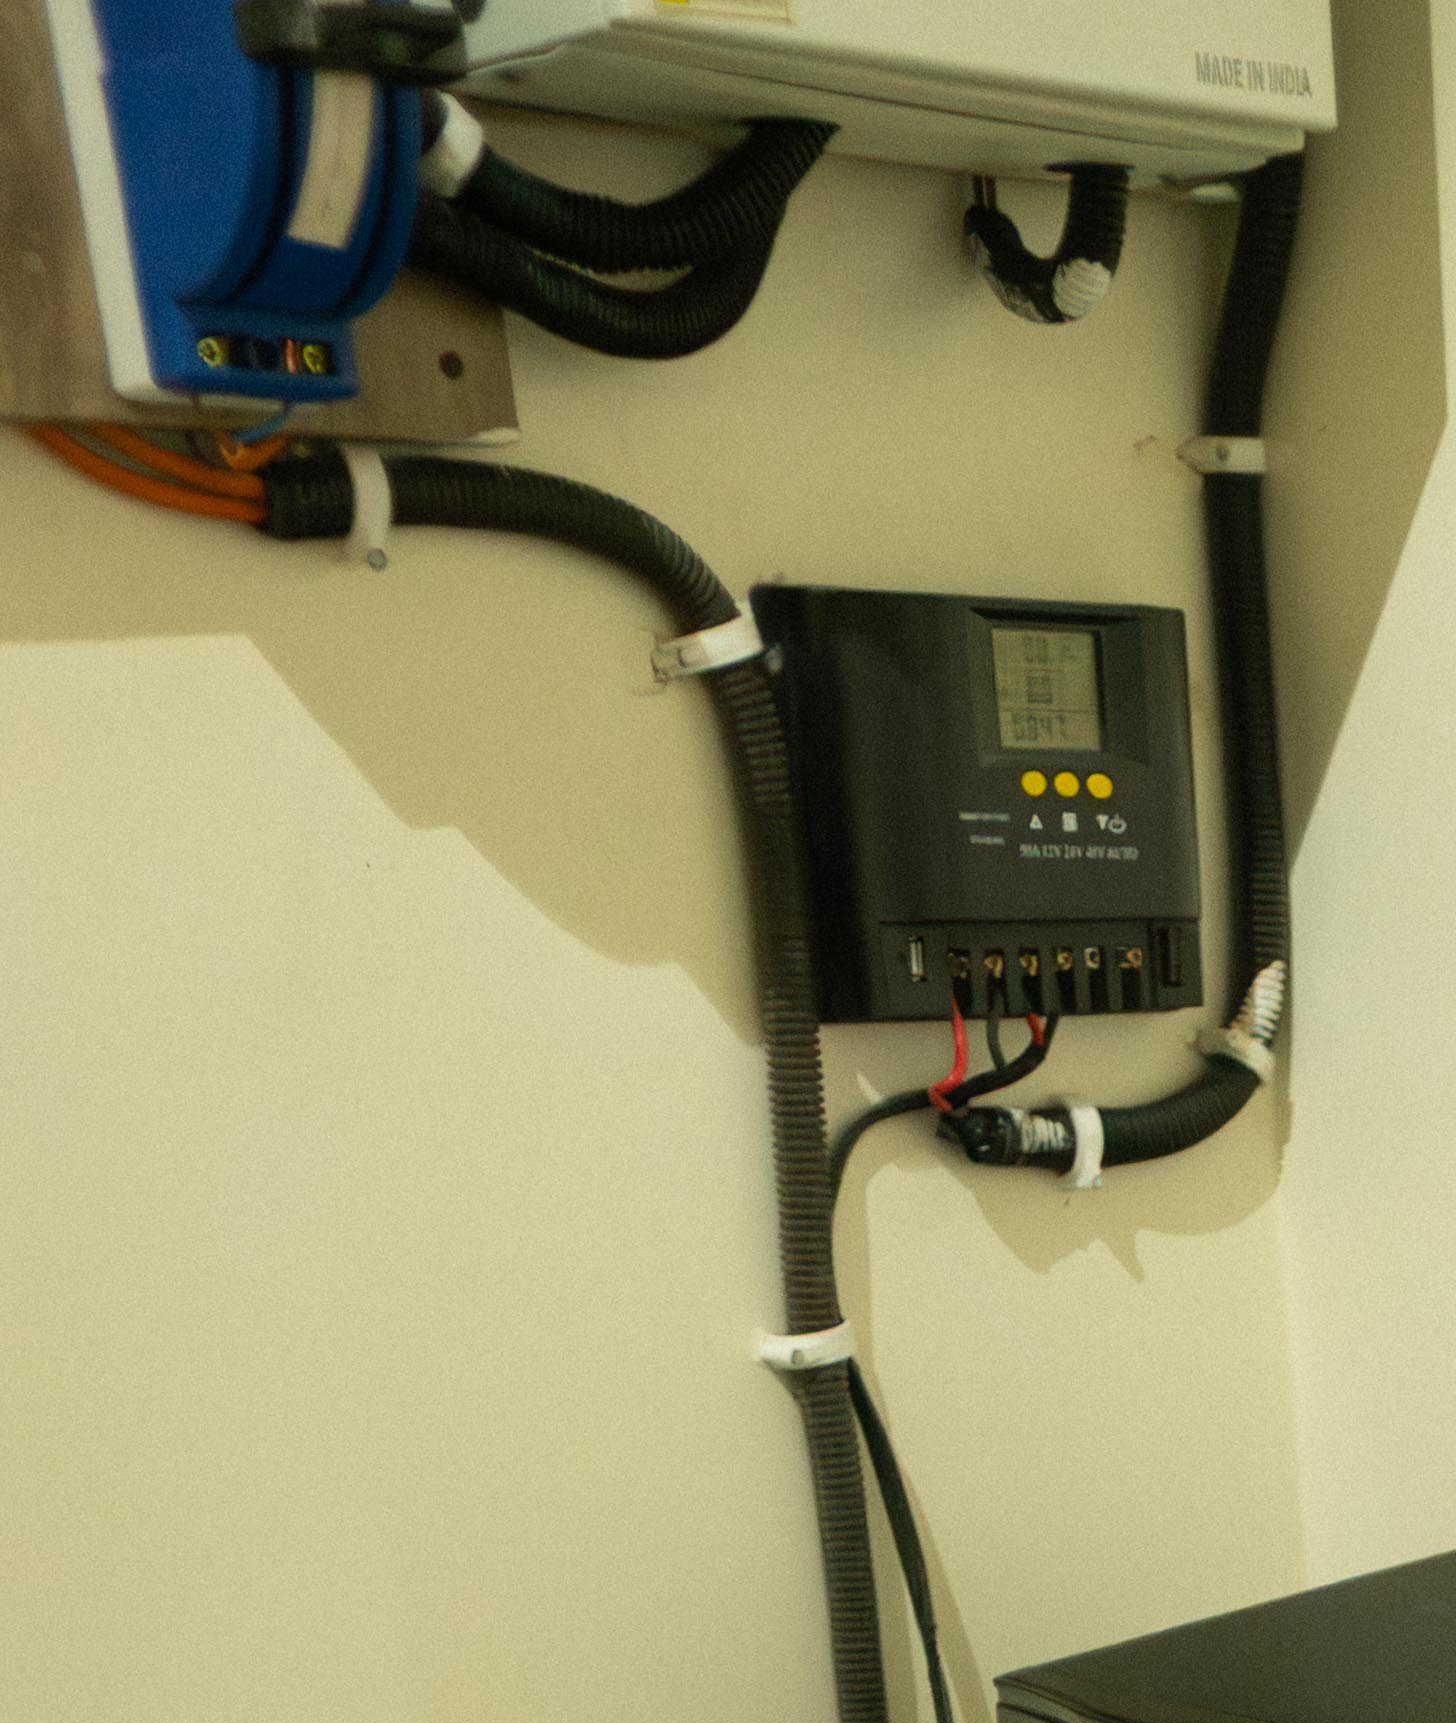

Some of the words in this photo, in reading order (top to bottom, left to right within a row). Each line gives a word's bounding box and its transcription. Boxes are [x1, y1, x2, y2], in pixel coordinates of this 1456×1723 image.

[1194, 50, 1243, 89] MADE
[1246, 58, 1265, 92] IN
[1267, 61, 1313, 97] INDIA
